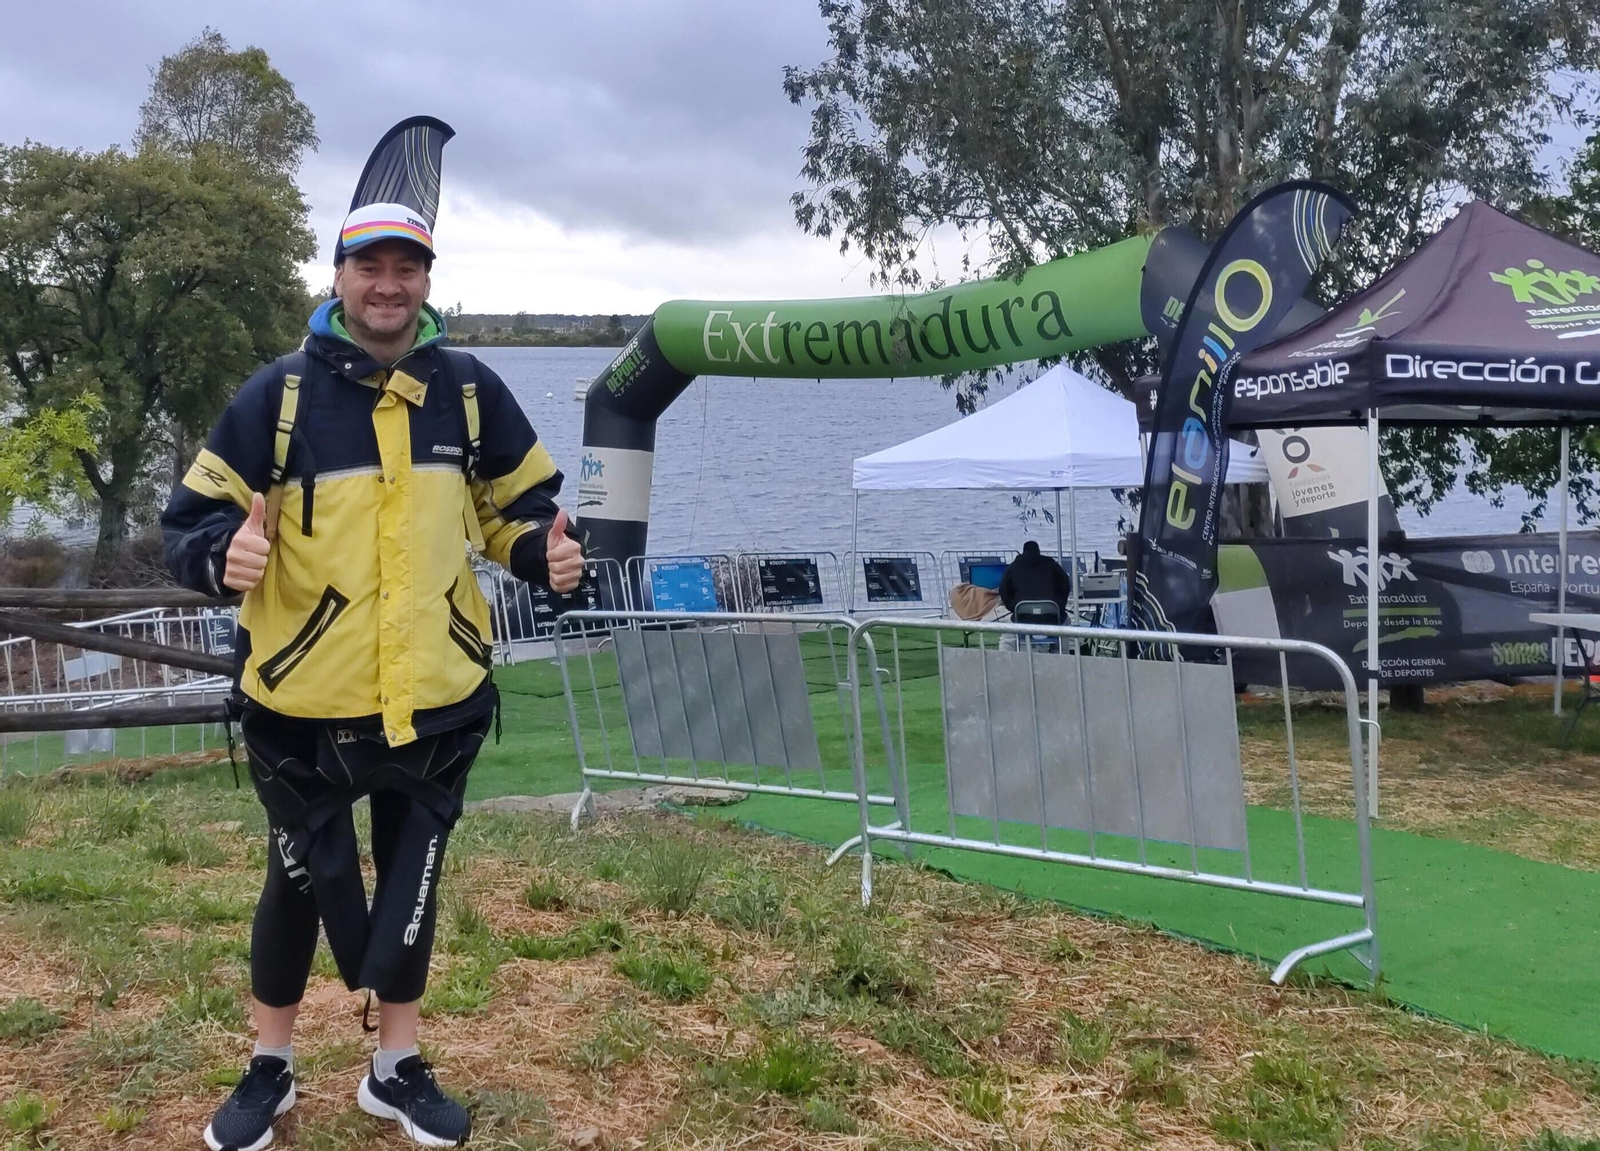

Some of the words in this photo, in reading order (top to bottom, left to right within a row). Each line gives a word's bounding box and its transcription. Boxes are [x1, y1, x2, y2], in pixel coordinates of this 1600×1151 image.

[703, 291, 1074, 365] Extremadura
[605, 345, 647, 393] DEPORTE
[1235, 359, 1350, 400] esponsable
[1386, 354, 1566, 384] Dirección
[1202, 509, 1213, 541] CENTRO
[1208, 450, 1221, 510] INTERNACIONAL
[1294, 499, 1300, 508] y
[1300, 491, 1336, 504] deporte
[1502, 550, 1600, 575] Intere
[1510, 581, 1550, 595] España
[1347, 593, 1428, 605] Extmadura
[1384, 617, 1410, 626] desde
[1412, 617, 1421, 626] la
[1423, 617, 1443, 626] Base
[1381, 670, 1393, 678] DE
[1394, 668, 1435, 678] DEPORTES
[1411, 659, 1446, 667] GENERAL
